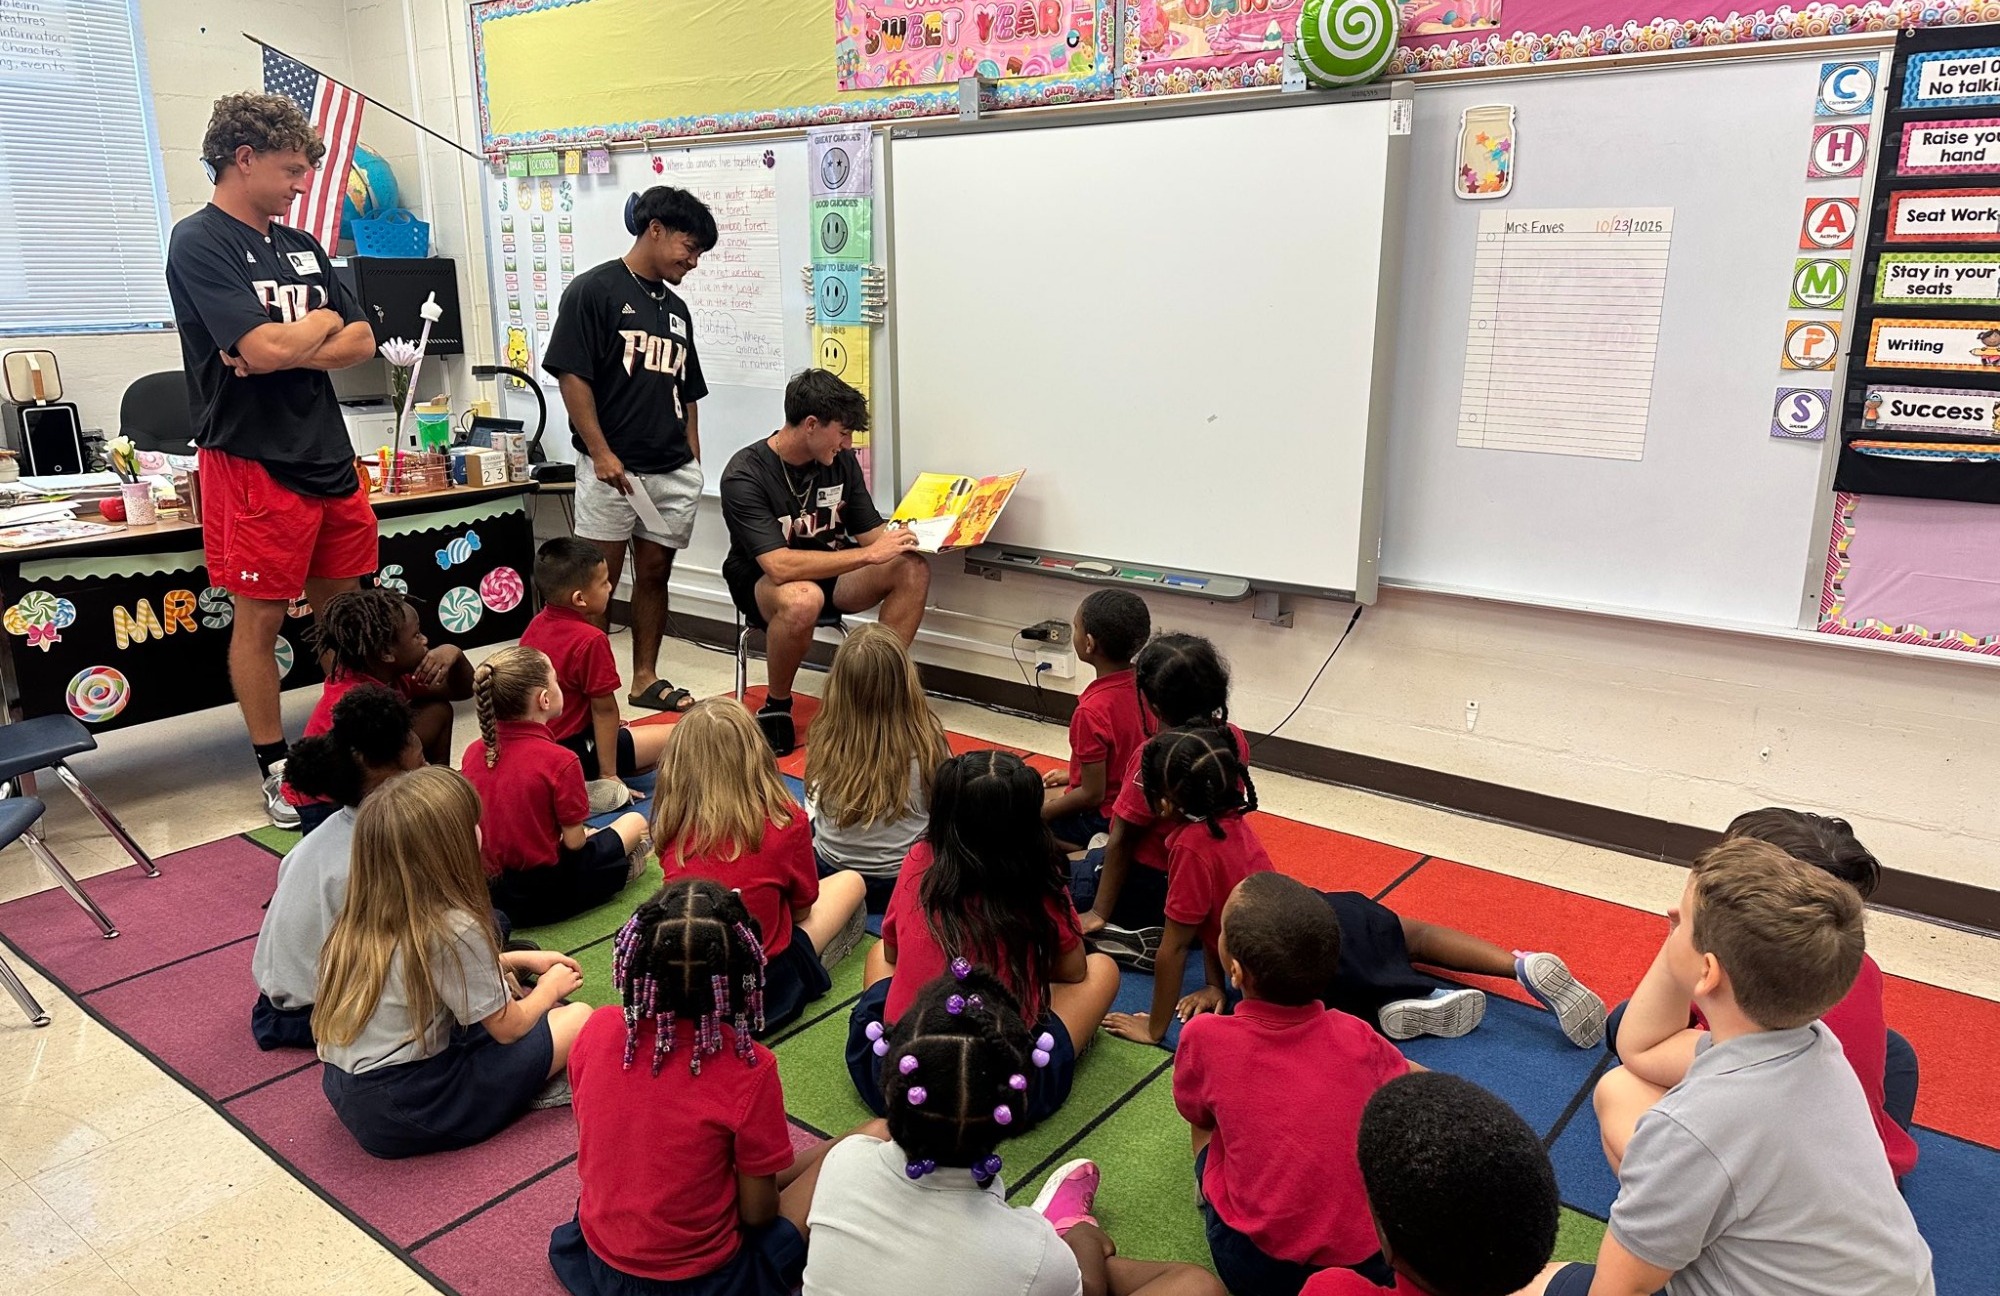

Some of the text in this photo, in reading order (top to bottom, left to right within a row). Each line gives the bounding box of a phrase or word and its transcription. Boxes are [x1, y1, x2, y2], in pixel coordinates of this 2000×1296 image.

[12, 0, 40, 11] learn
[0, 10, 46, 26] features
[0, 27, 66, 43] information
[865, 1, 1062, 56] SWEET YEAR
[1100, 10, 1108, 52] CANDY
[1107, 16, 1115, 44] LAND
[21, 60, 65, 72] events
[1938, 60, 1985, 77] Level
[1833, 68, 1860, 99] C
[1929, 82, 1953, 96] No
[1044, 86, 1075, 98] CANDY
[1051, 95, 1071, 103] LAND
[818, 107, 844, 118] CANDY
[889, 100, 917, 111] CANDY
[754, 113, 777, 124] CANDY
[895, 109, 912, 117] LAND
[638, 124, 659, 133] CANDY
[695, 119, 716, 129] CANDY
[540, 134, 557, 143] CANDY
[587, 129, 605, 138] CANDY
[815, 135, 832, 144] GREAT
[1922, 131, 1968, 146] Raise
[1827, 131, 1854, 161] H
[1940, 148, 1986, 162] hand
[725, 186, 745, 200] water
[815, 199, 858, 208] GOOD CHOICES
[1815, 203, 1846, 233] A
[1906, 207, 1998, 223] Seat Work
[744, 217, 768, 231] forest
[1531, 220, 1565, 234] Eaves
[1595, 214, 1663, 237] 10/23/2025
[1801, 265, 1837, 294] M
[1891, 265, 1997, 281] Stay in your
[1906, 282, 1953, 296] seats
[1803, 327, 1825, 355] P
[1887, 339, 1944, 354] Writing
[1791, 394, 1812, 423] S
[1890, 399, 1985, 421] Success
[113, 586, 233, 649] MRS
